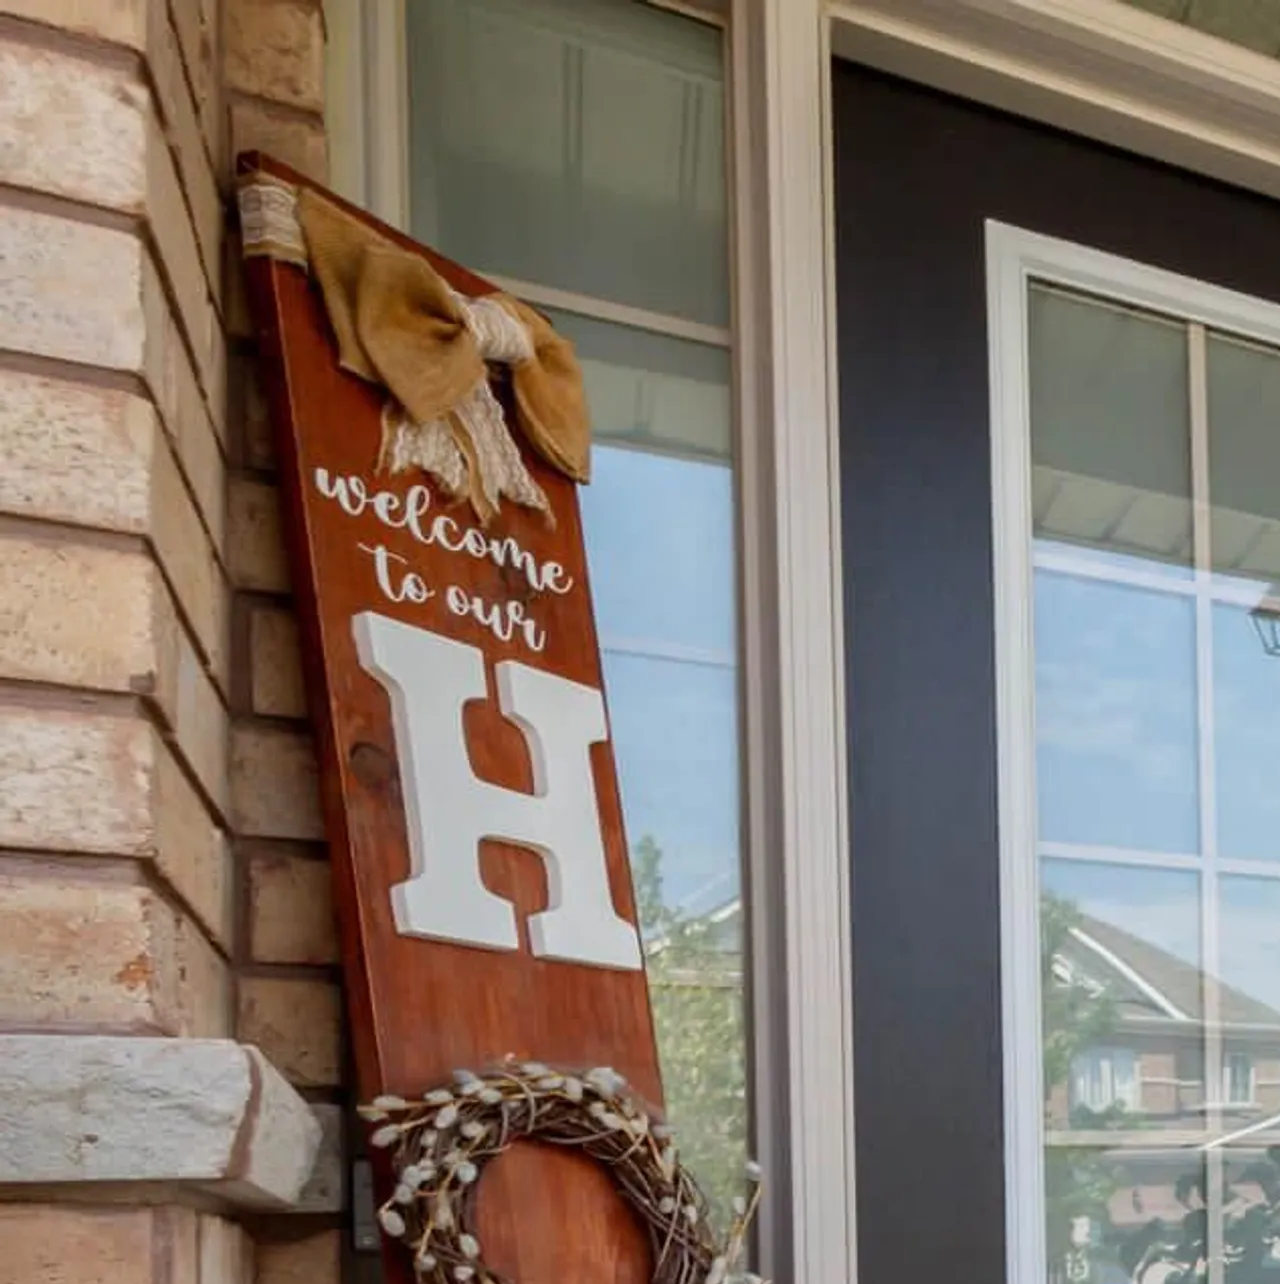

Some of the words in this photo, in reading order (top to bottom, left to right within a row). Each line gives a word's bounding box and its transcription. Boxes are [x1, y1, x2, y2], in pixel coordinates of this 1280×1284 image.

[314, 466, 575, 594] welcome
[356, 540, 435, 603] to
[446, 583, 548, 652] our
